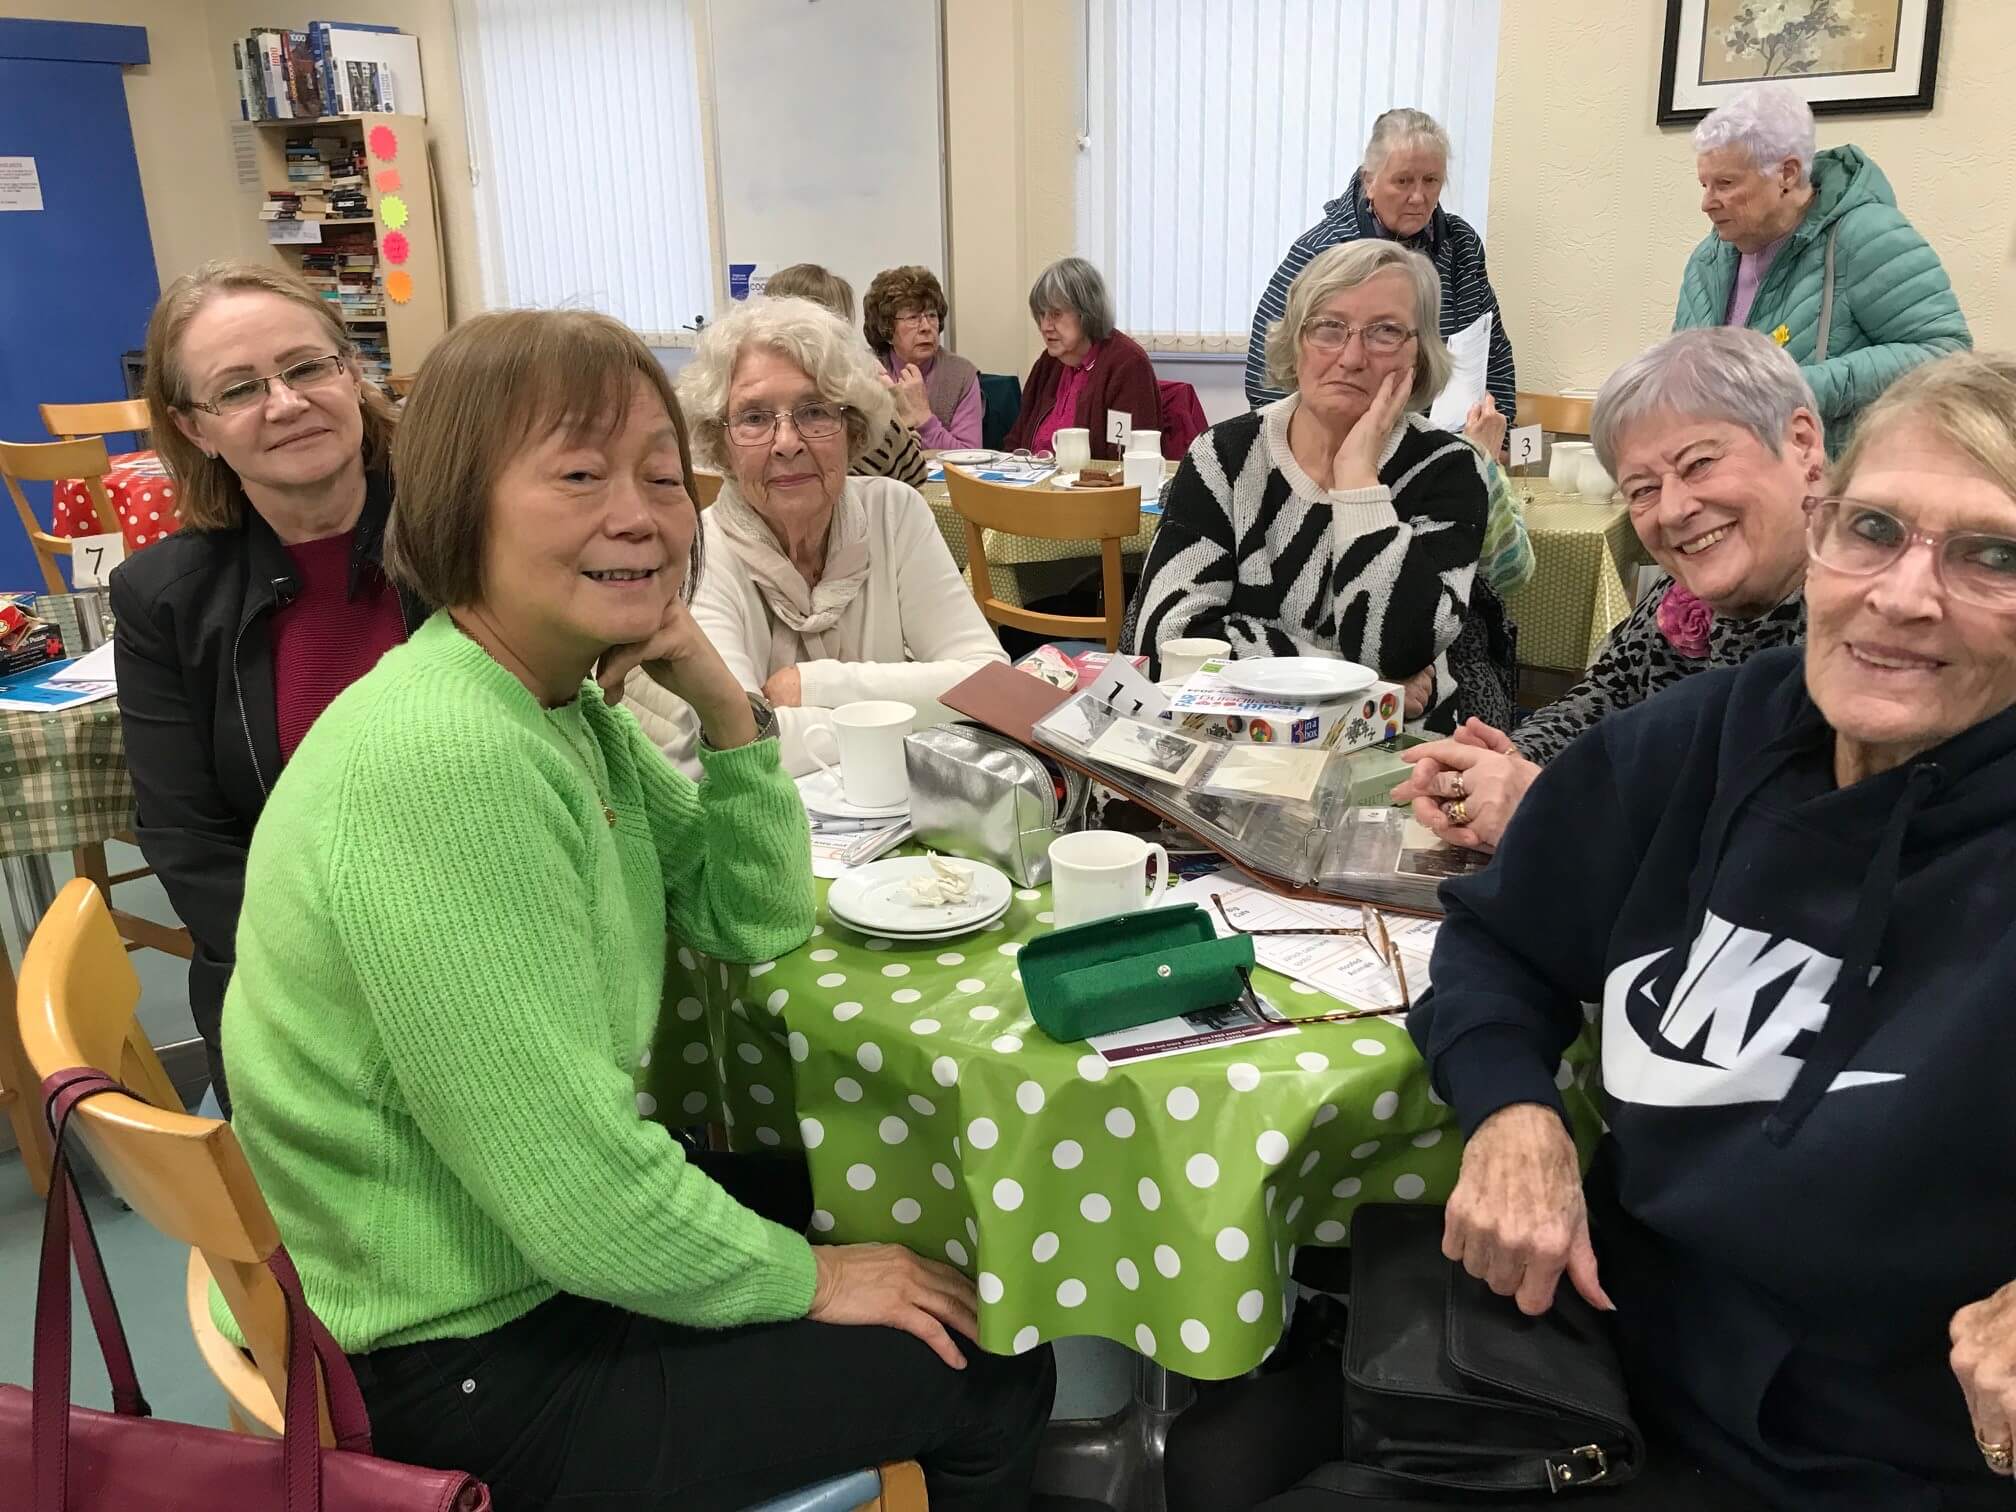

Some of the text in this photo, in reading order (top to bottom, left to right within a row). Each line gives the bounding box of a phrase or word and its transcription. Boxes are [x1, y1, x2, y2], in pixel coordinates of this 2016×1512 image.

[1115, 421, 1123, 438] 2
[1521, 437, 1531, 457] 3
[86, 547, 104, 575] 7
